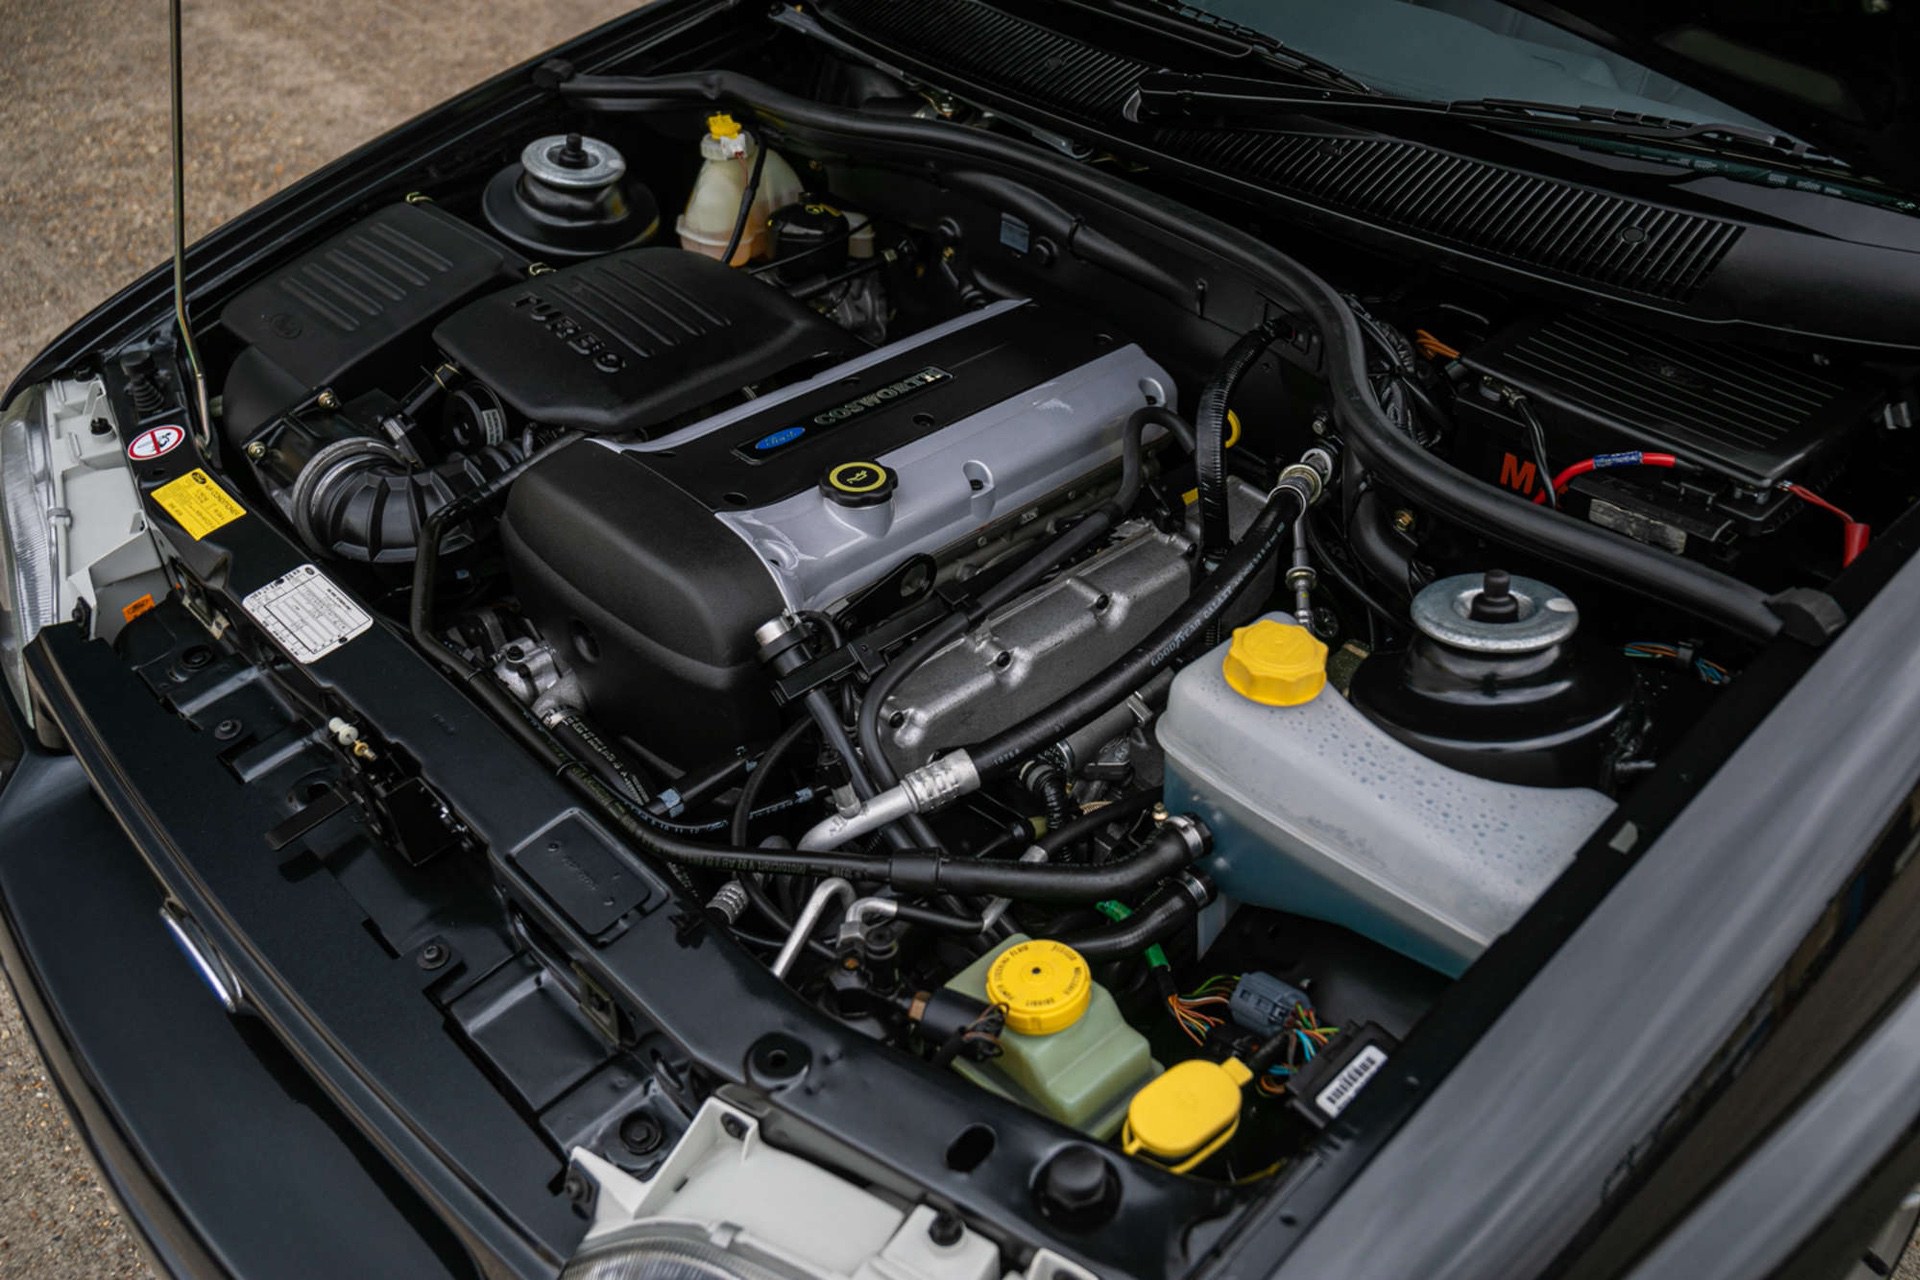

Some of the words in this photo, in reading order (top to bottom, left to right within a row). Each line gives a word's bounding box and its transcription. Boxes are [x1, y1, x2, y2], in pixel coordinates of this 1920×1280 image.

[511, 292, 626, 374] TURBO
[814, 366, 943, 426] COSWORTH
[1151, 618, 1203, 667] GOODYEAR
